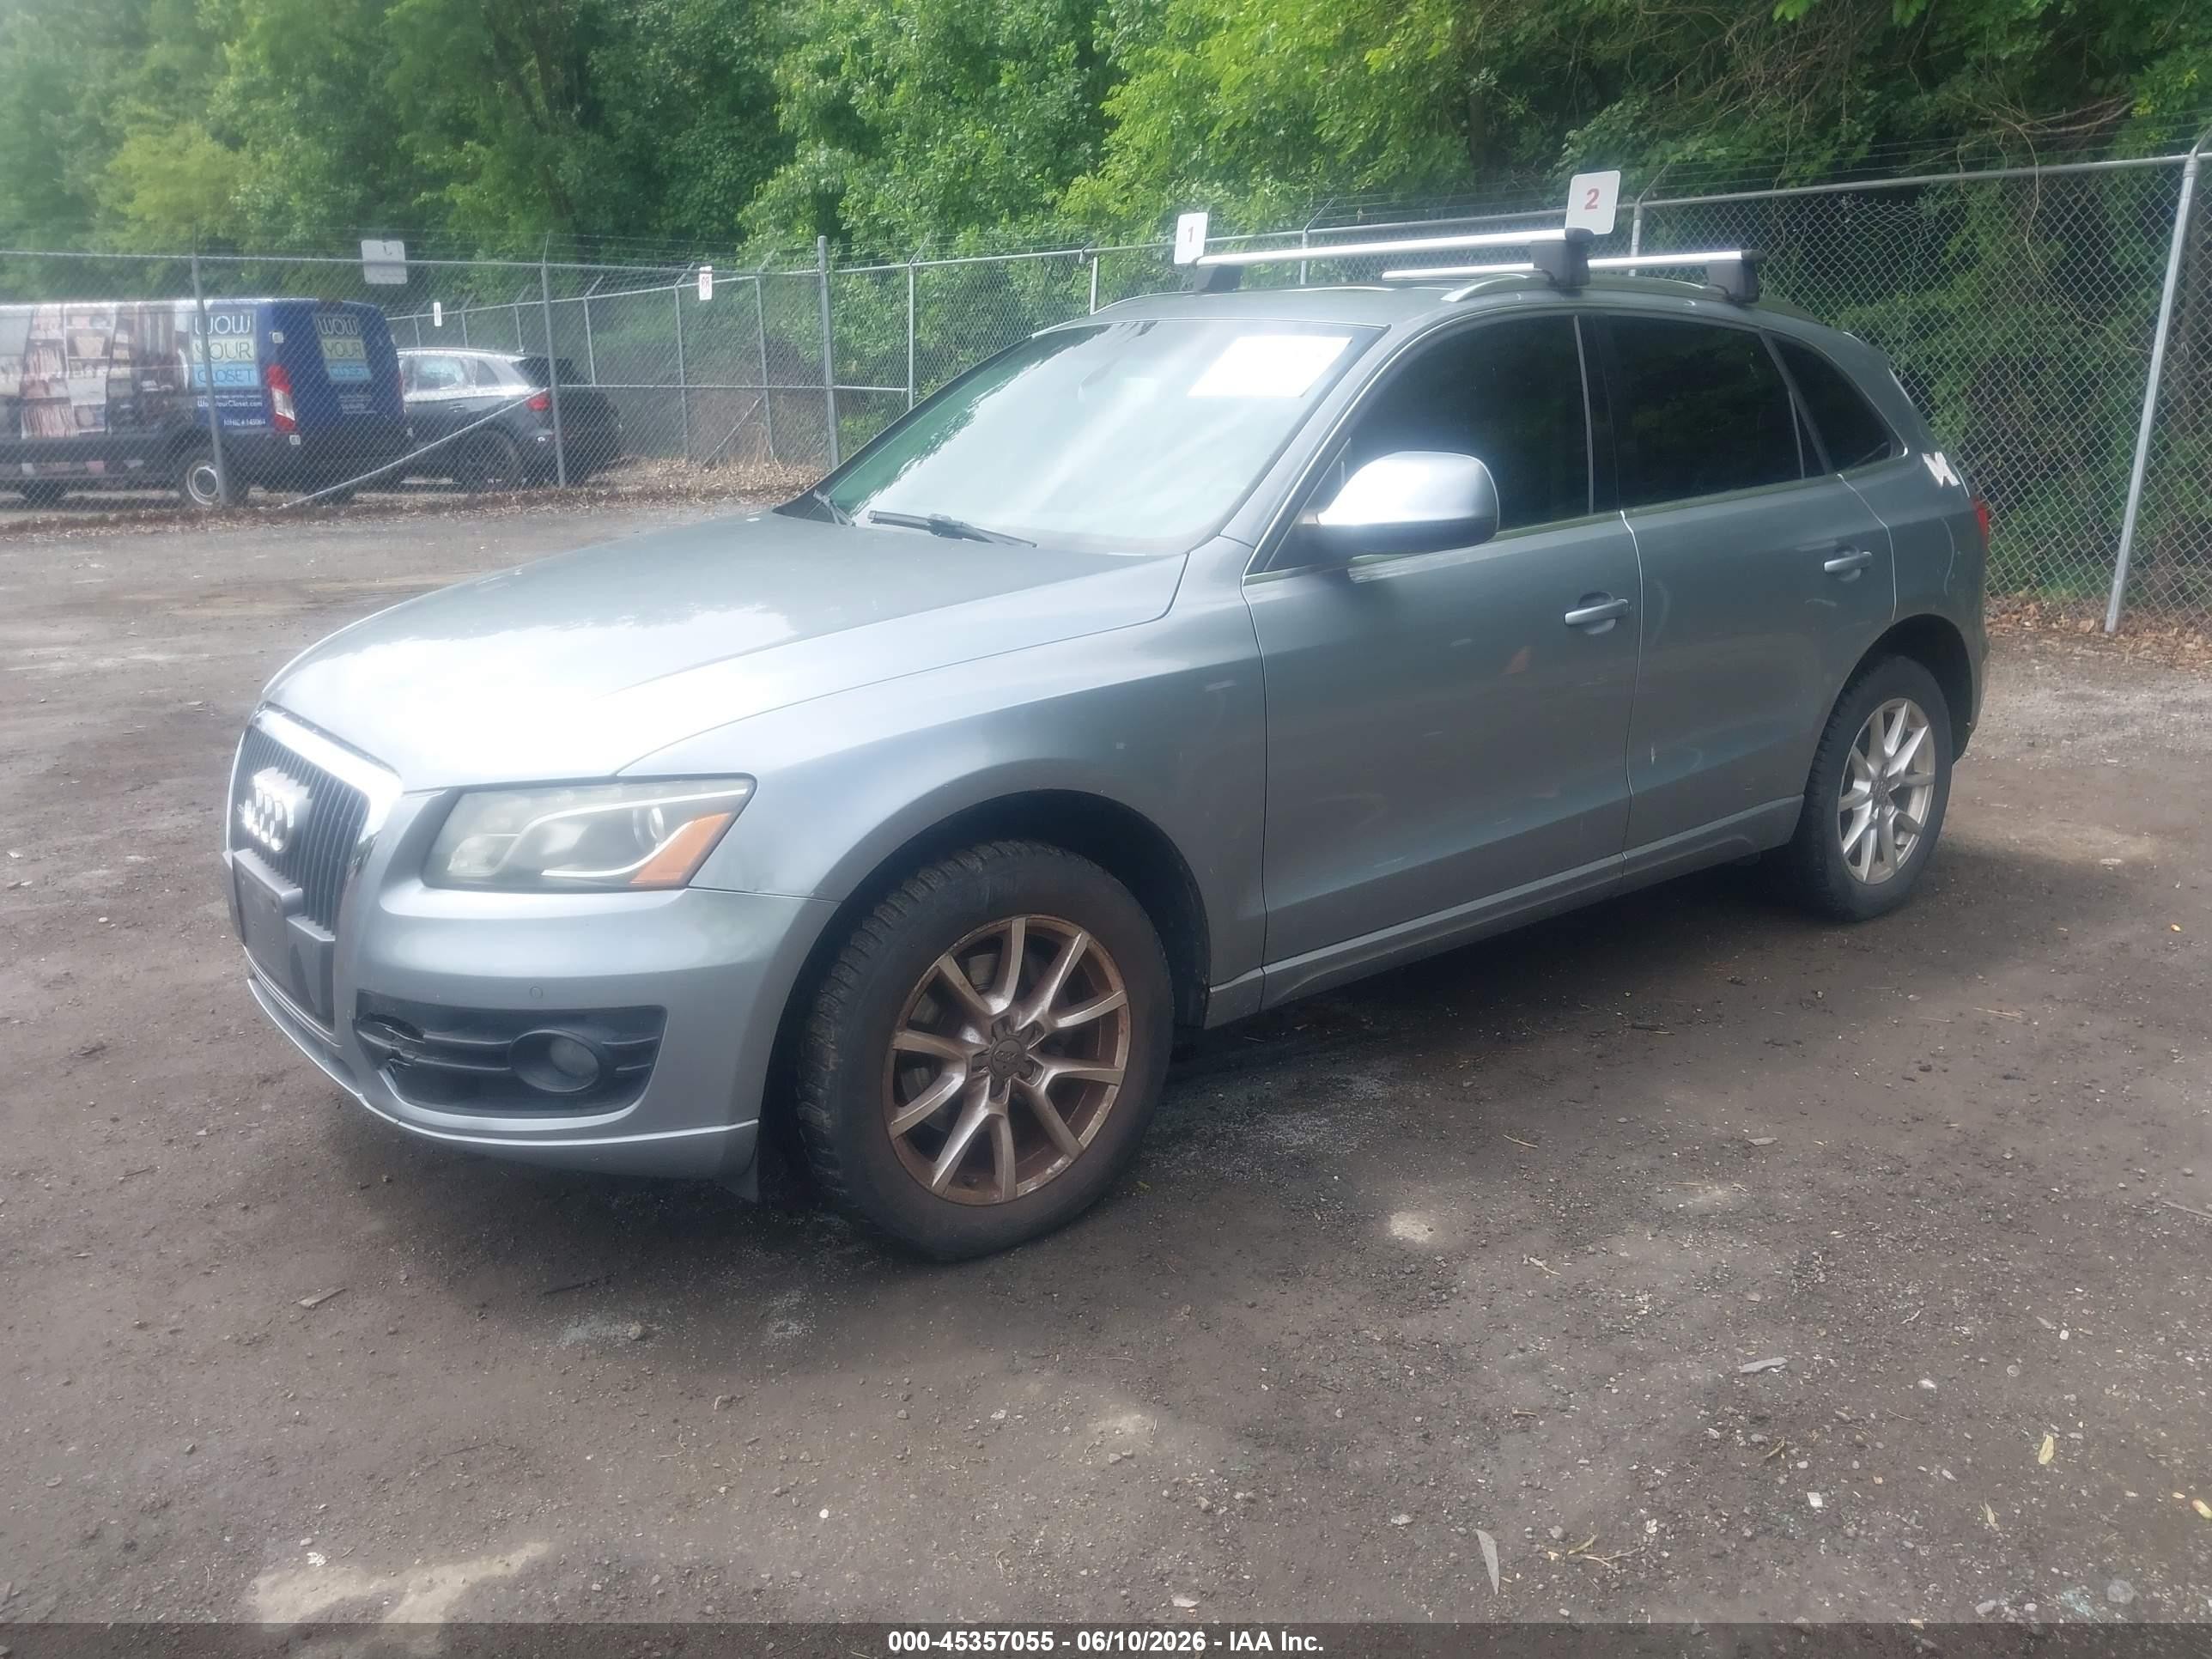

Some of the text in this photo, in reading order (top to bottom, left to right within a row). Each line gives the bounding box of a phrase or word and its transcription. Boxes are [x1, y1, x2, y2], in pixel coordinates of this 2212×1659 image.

[1584, 188, 1600, 210] 2
[1188, 226, 1194, 244] 1
[317, 317, 358, 336] WOW
[323, 342, 365, 358] YOUR
[198, 368, 252, 383] COSET
